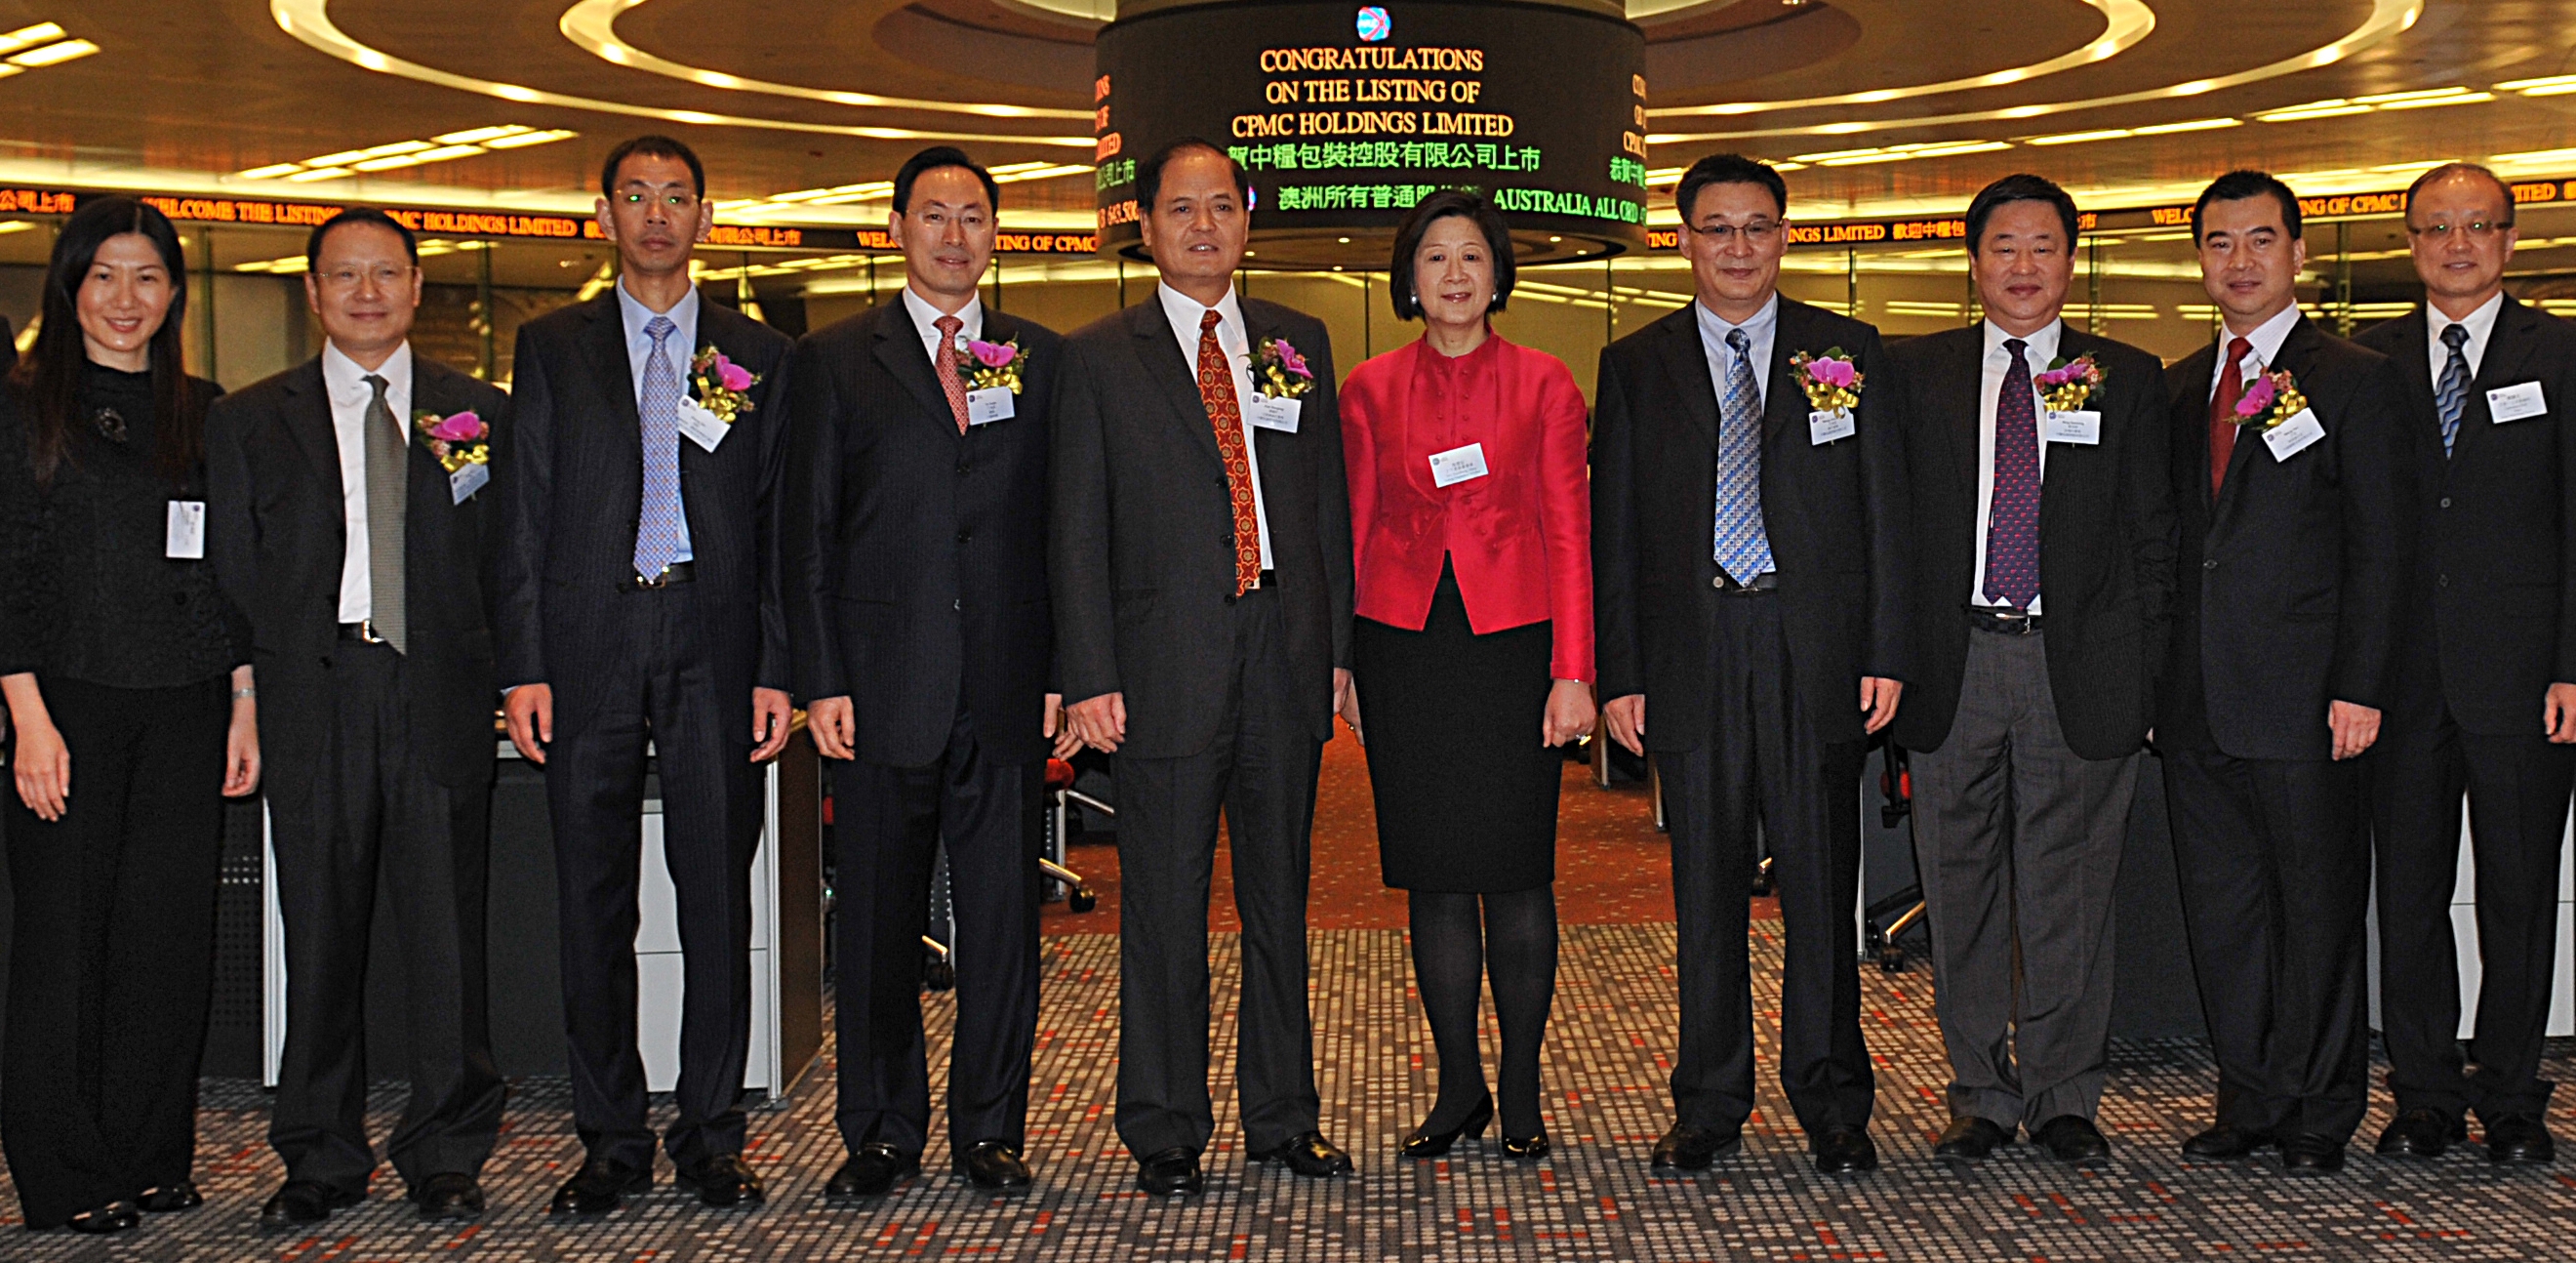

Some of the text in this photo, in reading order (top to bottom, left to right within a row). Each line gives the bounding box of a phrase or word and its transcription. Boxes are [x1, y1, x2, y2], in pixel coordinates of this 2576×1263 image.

[1260, 47, 1484, 73] CONGRATULATIONS
[1266, 78, 1481, 104] ON THE LISTING OF
[1231, 111, 1514, 138] CPMC HOLDINGS LIMITED
[142, 197, 236, 222] ELCOME
[236, 201, 274, 223] THE
[423, 212, 507, 234] HOLDINGS
[508, 216, 578, 237] LIMITED
[1494, 188, 1593, 217] AUSTRALIA
[1594, 197, 1619, 220] ALL
[2328, 197, 2351, 215] OF
[2352, 193, 2398, 213] CPMC
[1032, 235, 1054, 252] OF
[1055, 235, 1099, 252] CPMC
[1824, 224, 1885, 242] LIMITED
